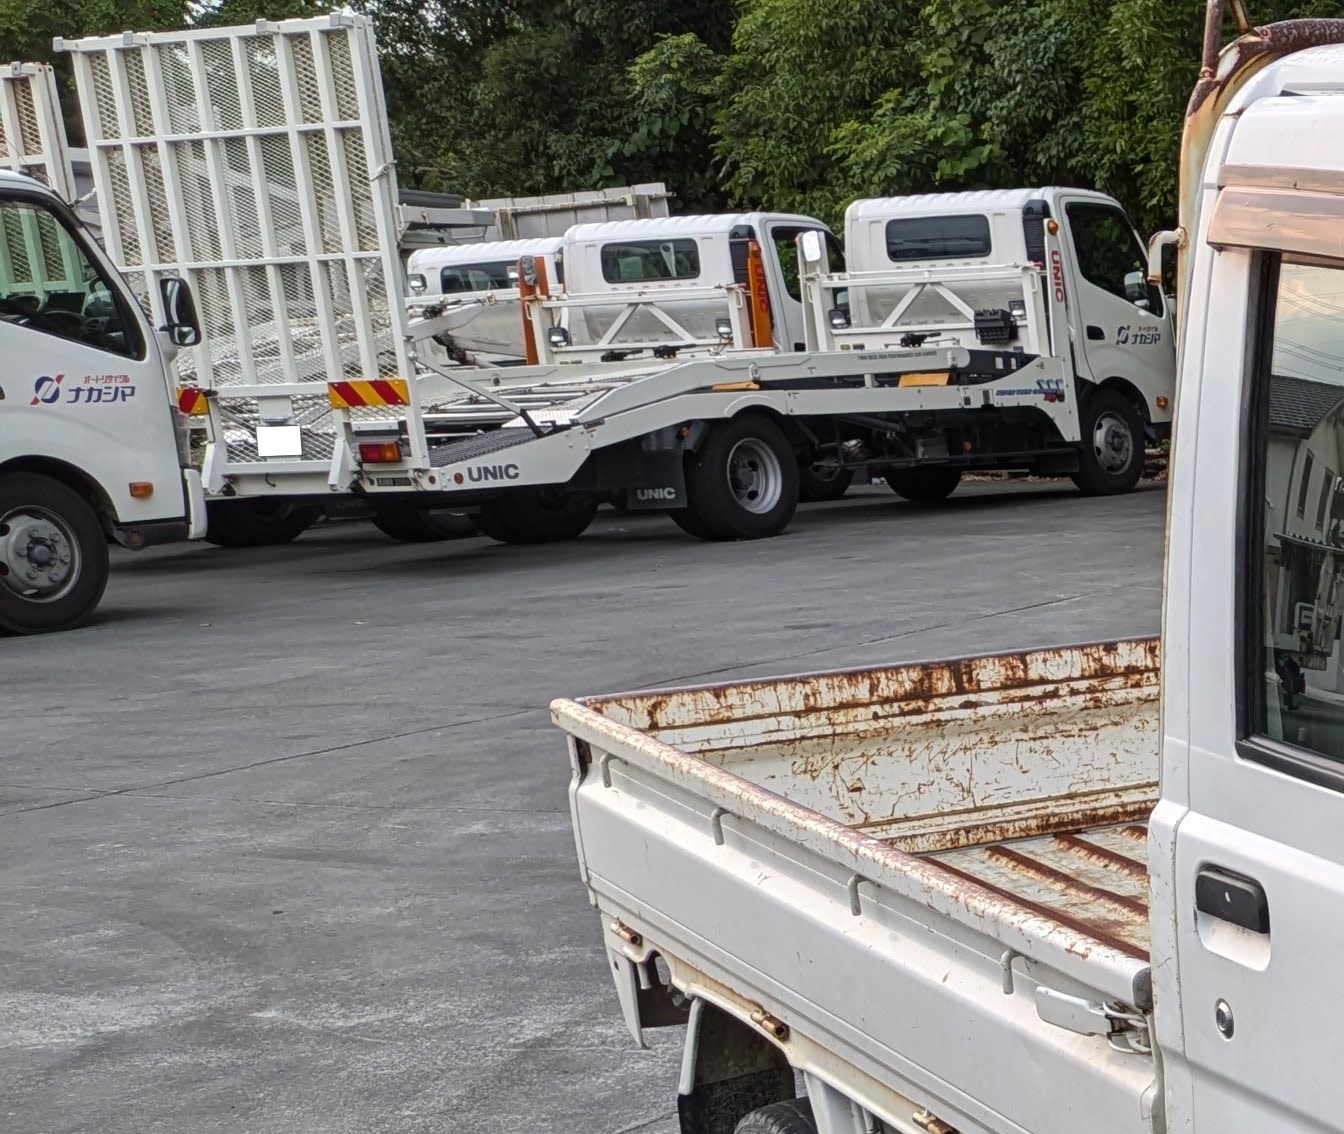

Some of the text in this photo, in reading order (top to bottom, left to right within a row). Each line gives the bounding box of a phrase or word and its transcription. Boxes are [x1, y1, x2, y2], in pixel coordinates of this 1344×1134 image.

[1051, 250, 1064, 303] UNIC
[754, 264, 769, 313] UNIC
[1131, 333, 1161, 345] ナカシマ
[66, 386, 136, 404] ナカシマ
[467, 463, 520, 482] UNIC
[637, 487, 676, 500] UNIC
